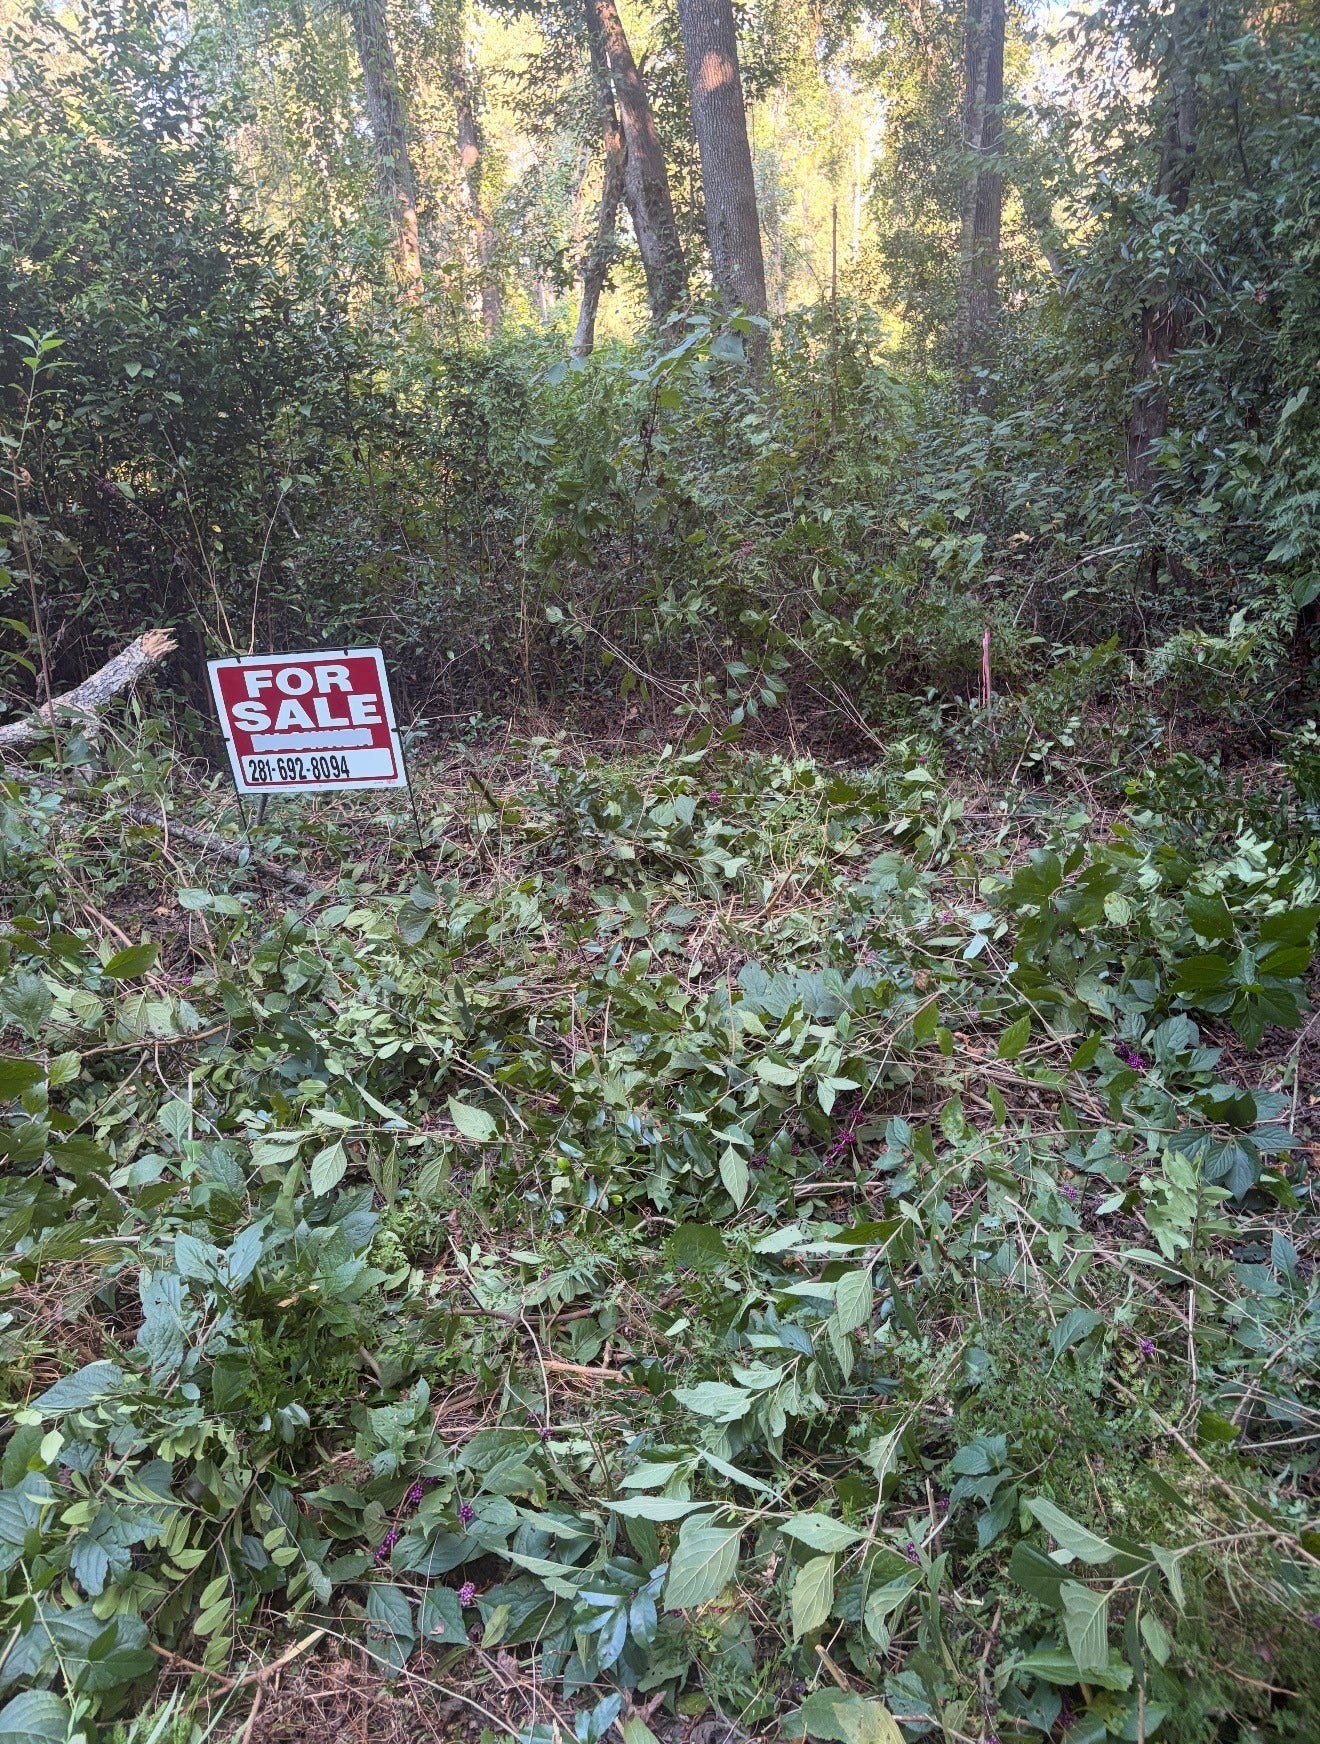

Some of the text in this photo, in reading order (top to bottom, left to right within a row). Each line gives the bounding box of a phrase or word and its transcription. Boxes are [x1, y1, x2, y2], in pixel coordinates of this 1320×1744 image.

[243, 664, 354, 699] FOR
[231, 693, 383, 732] SALE
[248, 755, 351, 783] 281-692-8094
